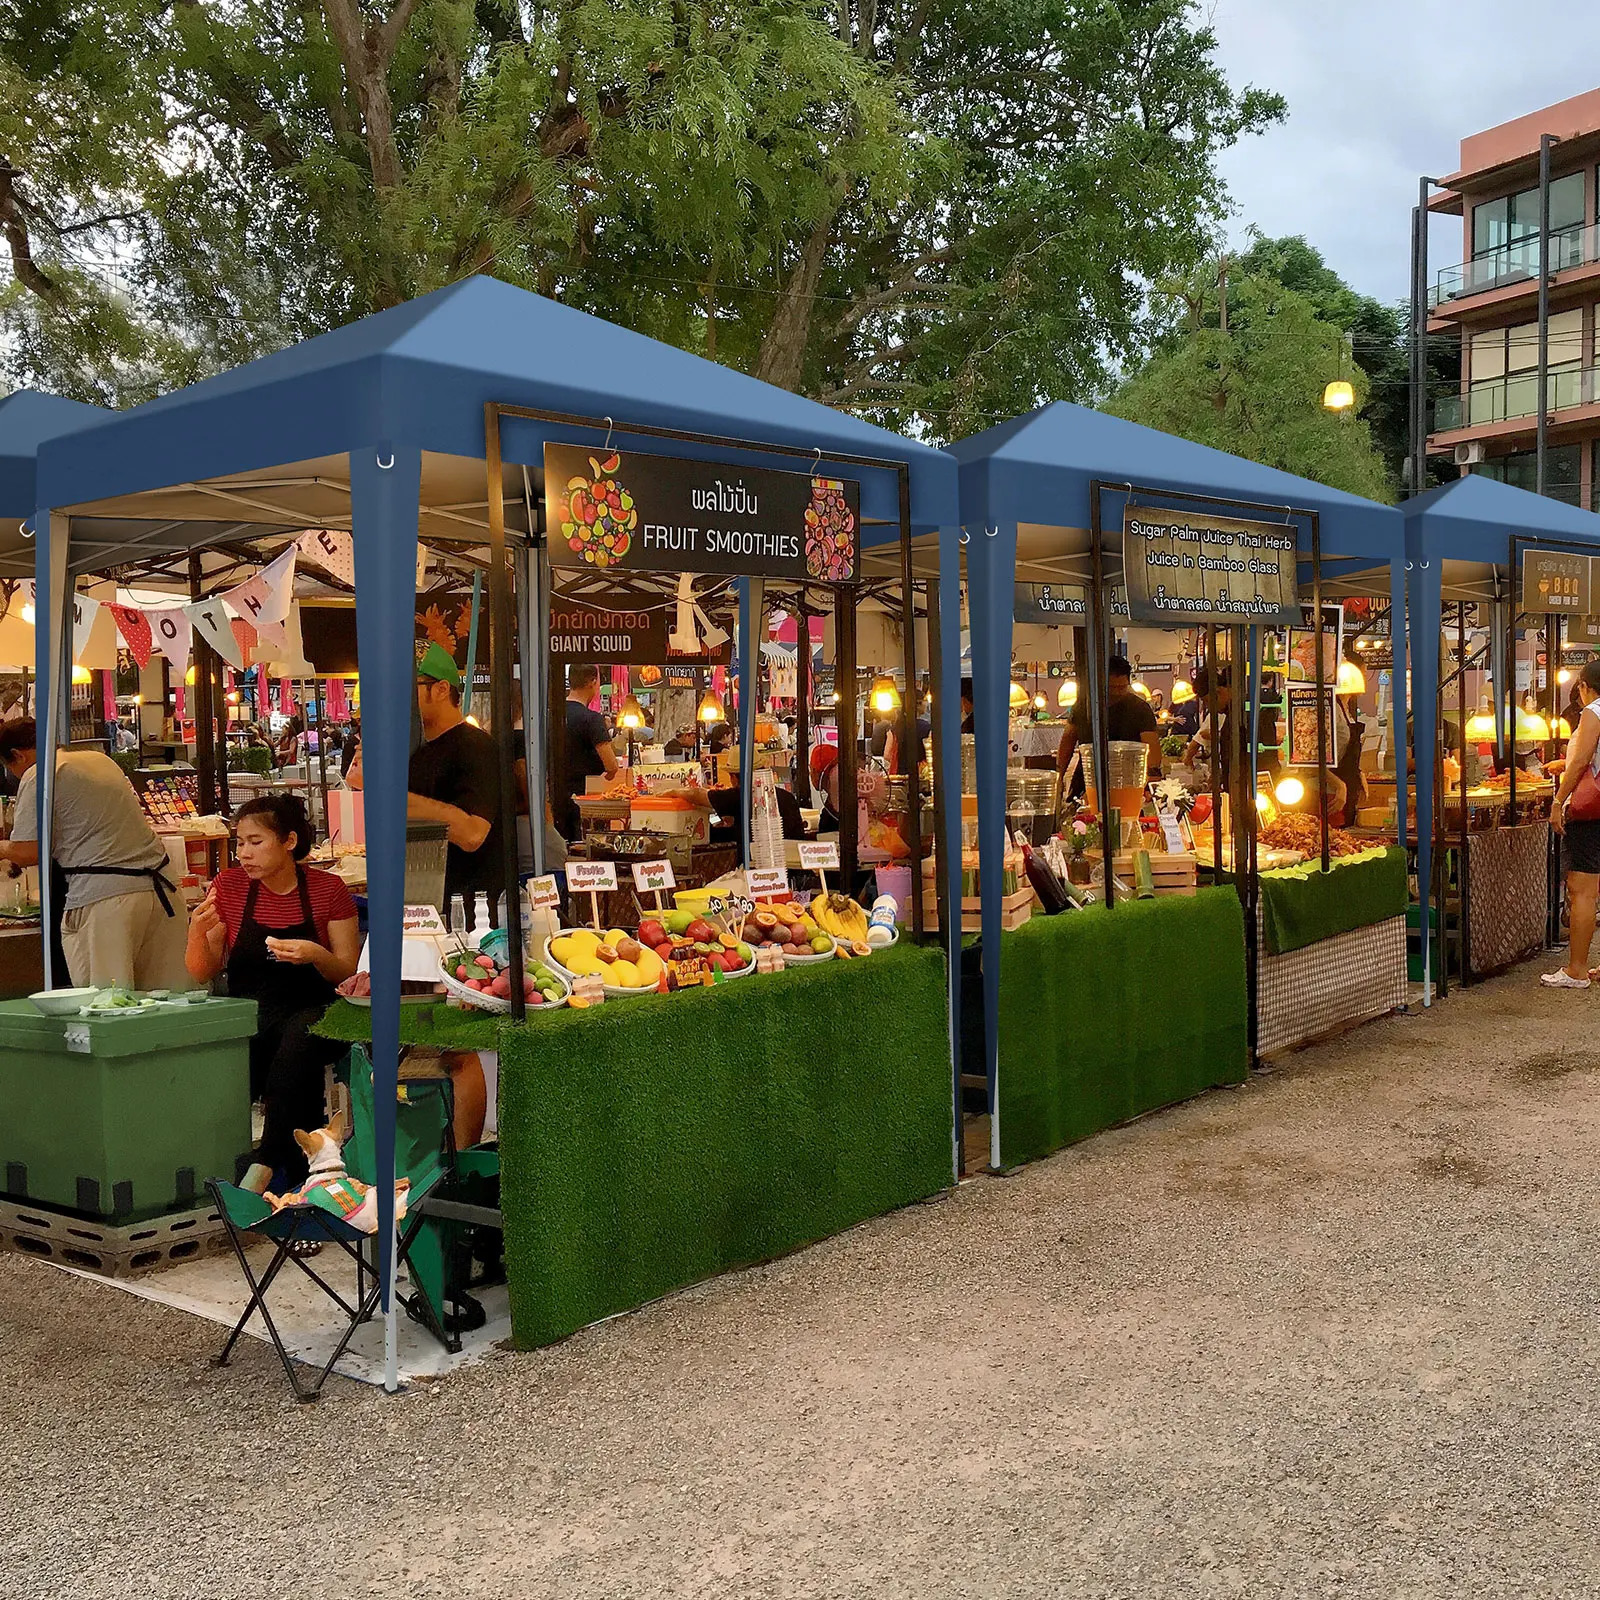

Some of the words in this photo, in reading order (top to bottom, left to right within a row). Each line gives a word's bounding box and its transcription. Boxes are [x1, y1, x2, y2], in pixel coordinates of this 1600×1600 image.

[692, 479, 758, 515] ผลไม้ปั่น
[643, 524, 699, 551] FRUIT
[705, 528, 799, 558] SMOOTHIES
[1130, 520, 1166, 540] Sugar
[1170, 525, 1199, 541] Palm
[1202, 530, 1233, 545] Juice
[1237, 533, 1262, 547] Thai
[1264, 535, 1292, 550] Herb
[1147, 552, 1179, 567] Juice
[1182, 554, 1195, 568] In
[1198, 556, 1245, 572] Bamboo
[1248, 559, 1278, 574] Glass
[1154, 586, 1212, 612] น้ำตาลสด
[1216, 590, 1280, 619] น้ำสมุนไพร
[550, 635, 589, 652] GIANT
[593, 635, 631, 652] SQUID
[640, 864, 666, 876] Apple
[571, 877, 596, 888] Yogurt
[740, 901, 753, 914] 80
